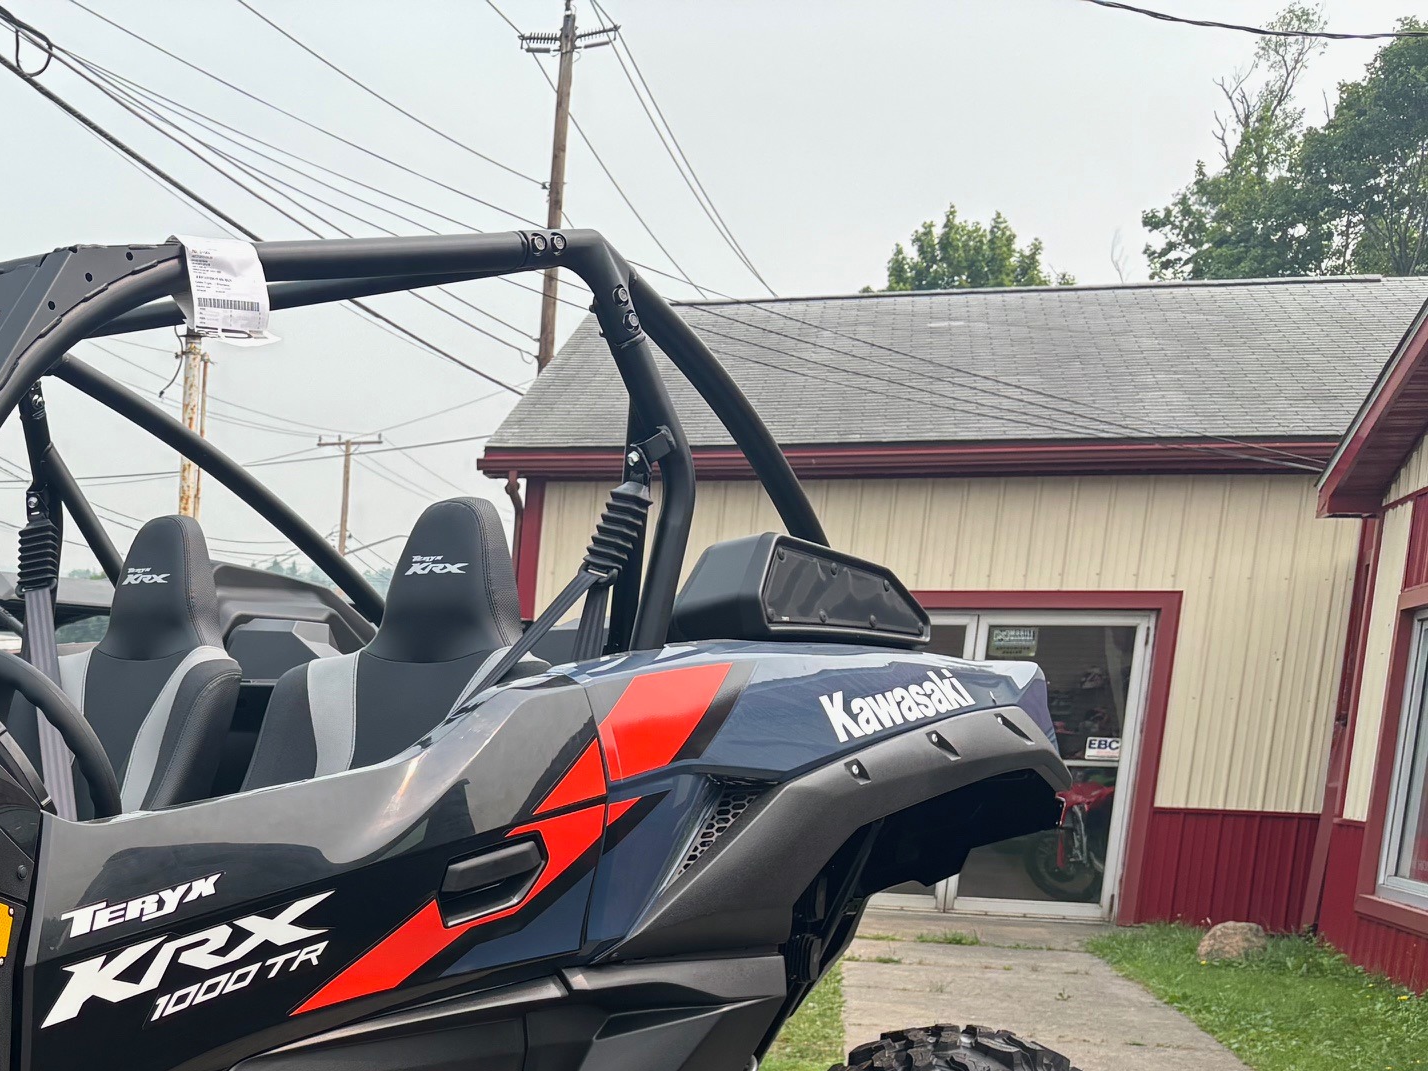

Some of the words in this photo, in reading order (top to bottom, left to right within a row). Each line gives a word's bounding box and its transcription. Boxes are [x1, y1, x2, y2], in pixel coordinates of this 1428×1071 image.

[404, 562, 470, 576] KRX
[121, 573, 171, 585] KRX
[819, 669, 976, 743] Kawasaki
[1088, 739, 1120, 750] EBC
[41, 890, 336, 1029] KRX
